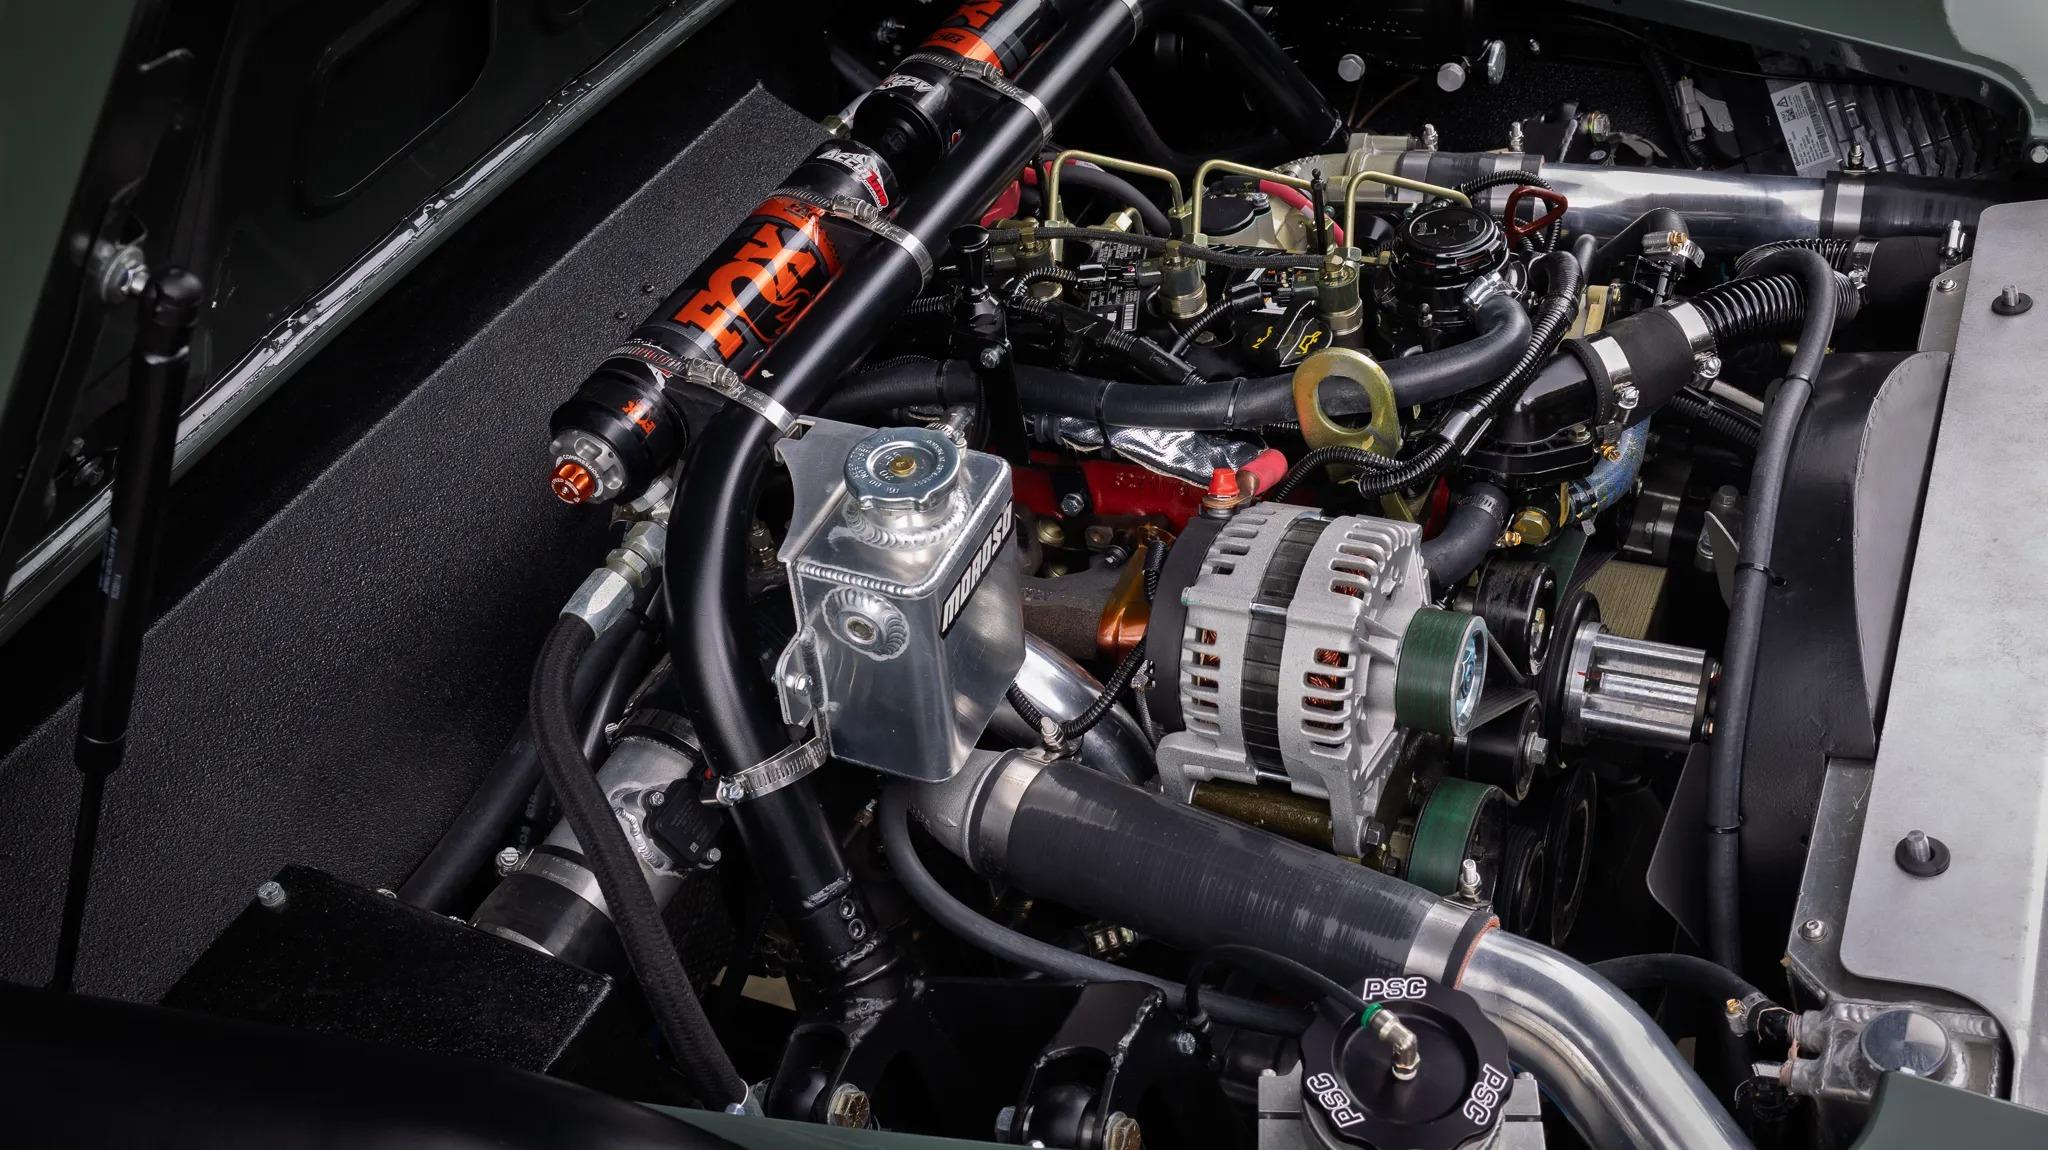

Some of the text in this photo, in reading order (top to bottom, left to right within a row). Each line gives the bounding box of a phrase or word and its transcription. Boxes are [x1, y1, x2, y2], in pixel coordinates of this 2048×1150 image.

[674, 224, 817, 359] FOX
[620, 398, 657, 435] FOX
[562, 454, 600, 479] COMPRESSION
[941, 501, 1013, 633] MOROSO
[1362, 976, 1428, 1000] PSC
[1306, 1071, 1365, 1128] PSC
[1464, 1063, 1508, 1126] PSC
